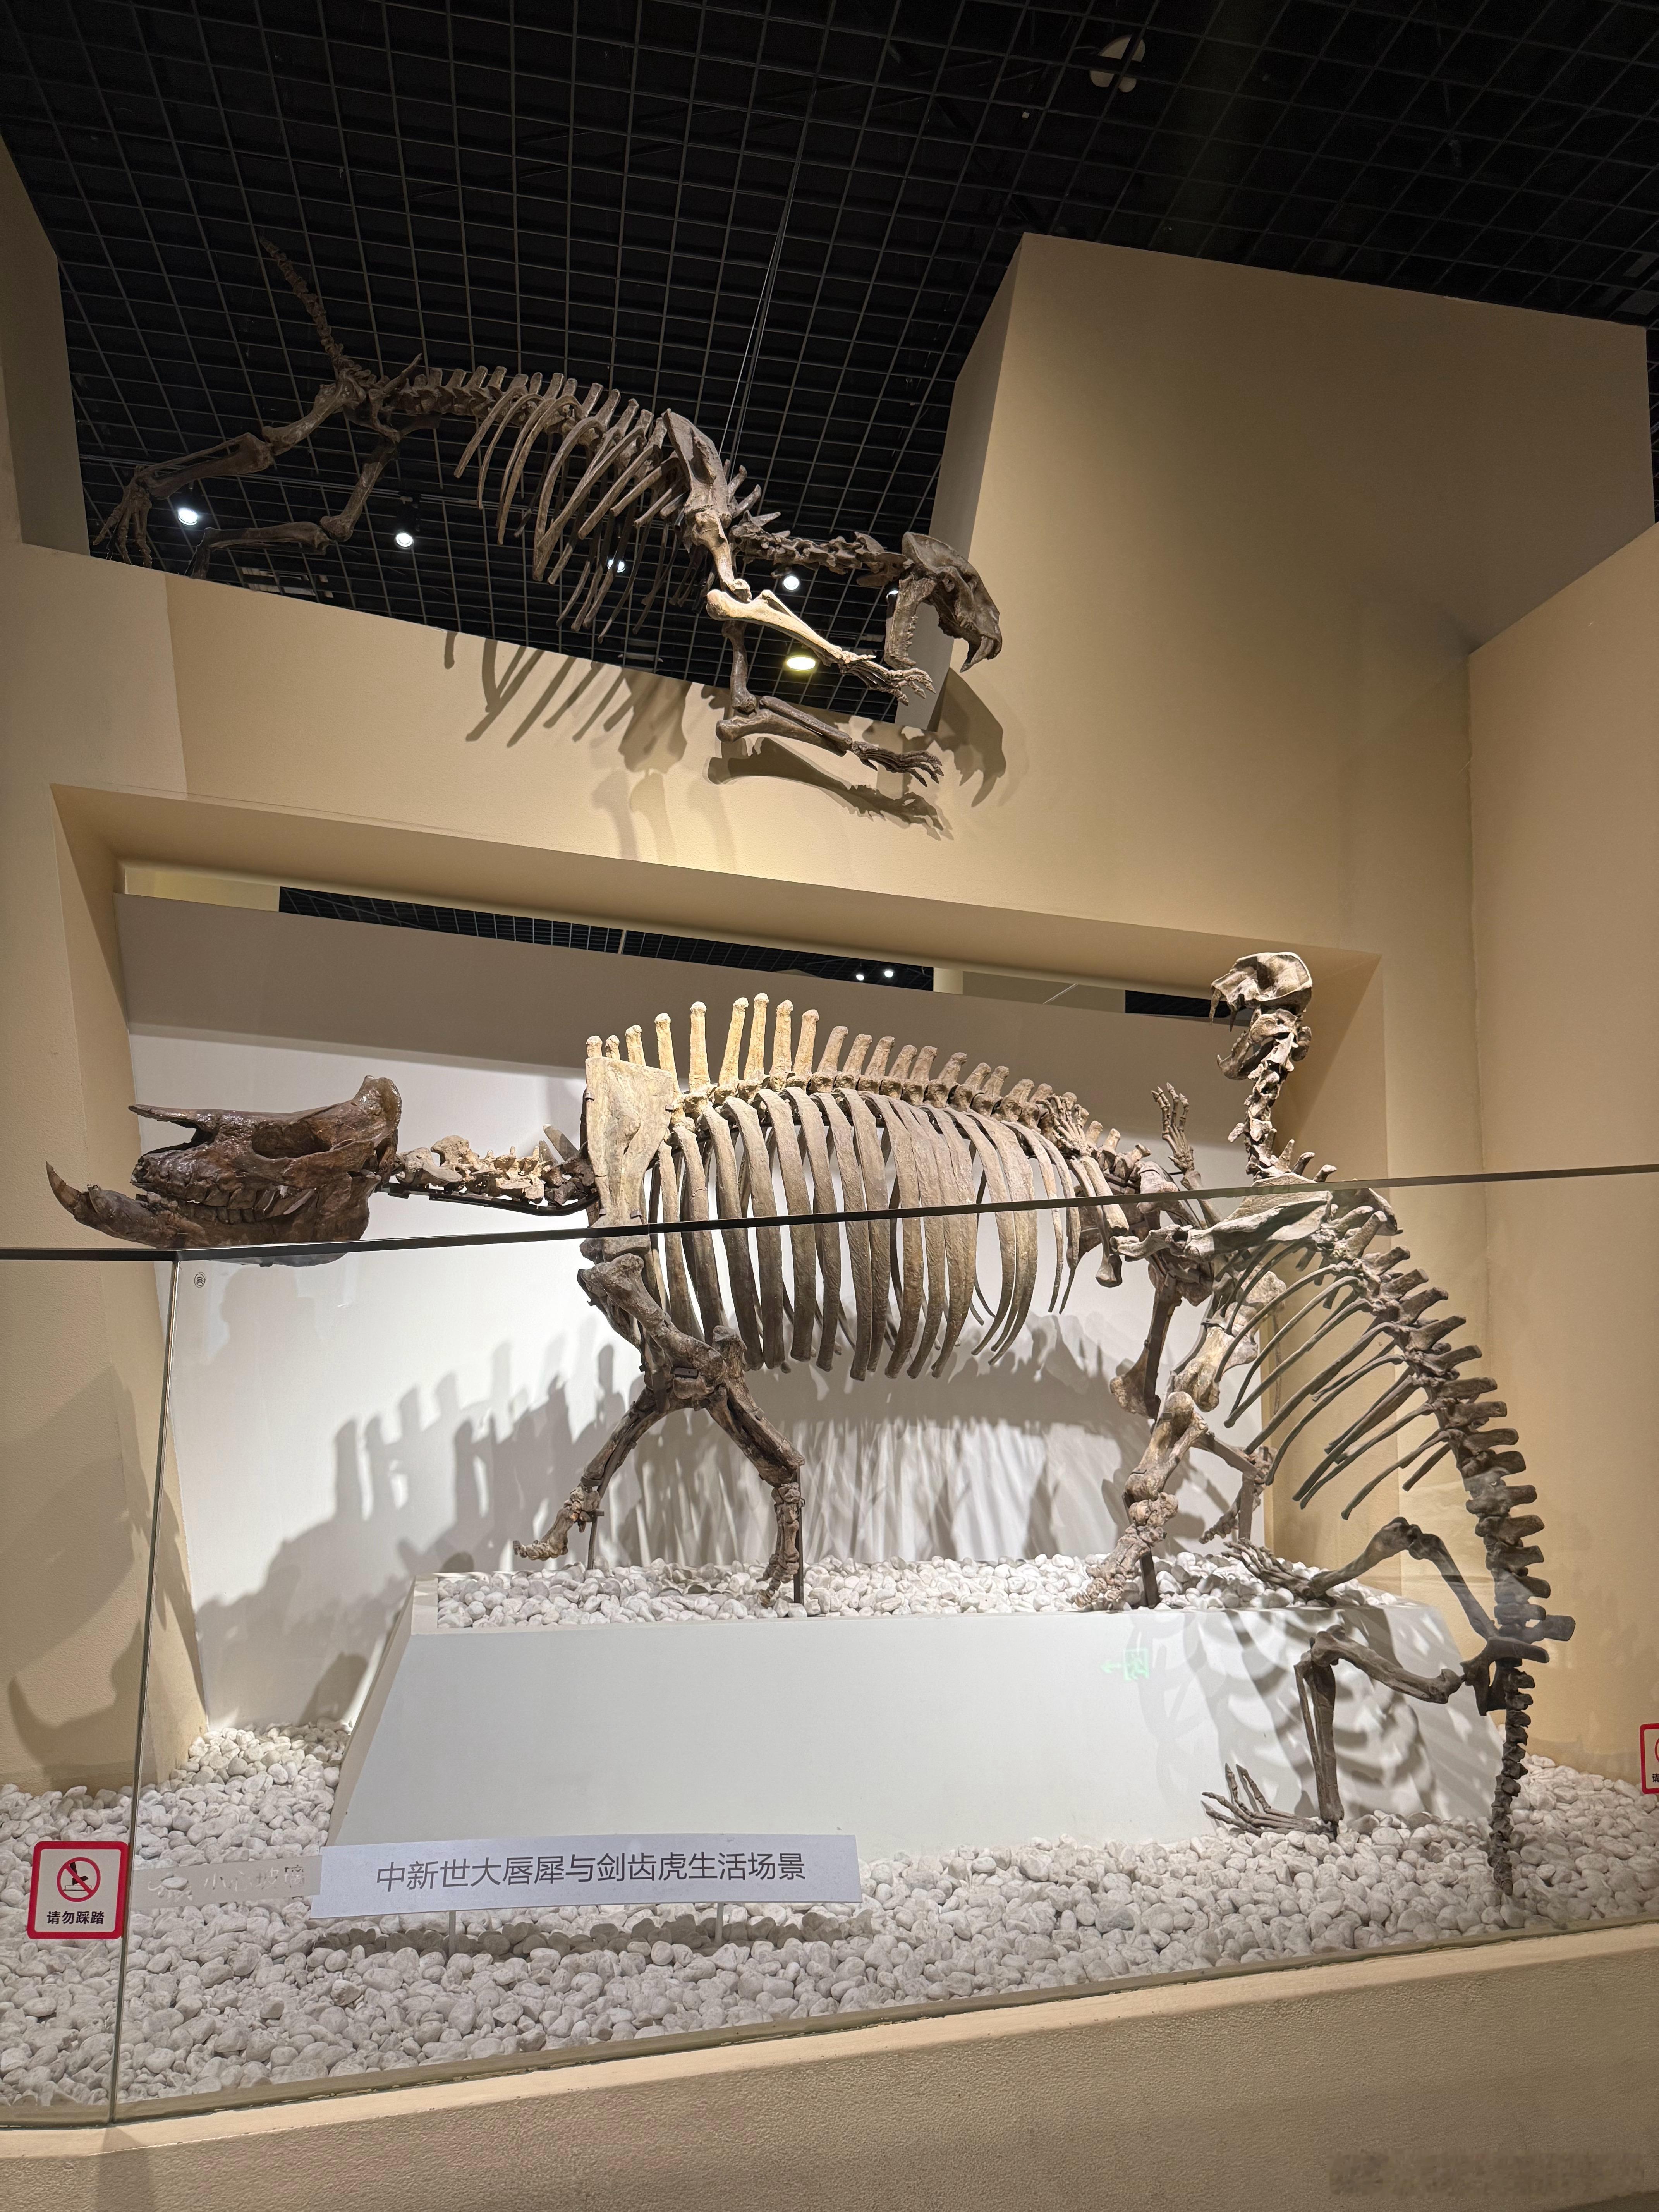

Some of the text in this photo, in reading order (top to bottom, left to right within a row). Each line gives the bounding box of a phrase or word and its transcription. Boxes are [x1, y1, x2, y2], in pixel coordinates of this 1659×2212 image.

[376, 1851, 806, 1892] 中新世大唇犀与剑齿虎生活场景
[46, 1911, 105, 1925] 请勿踩踏
